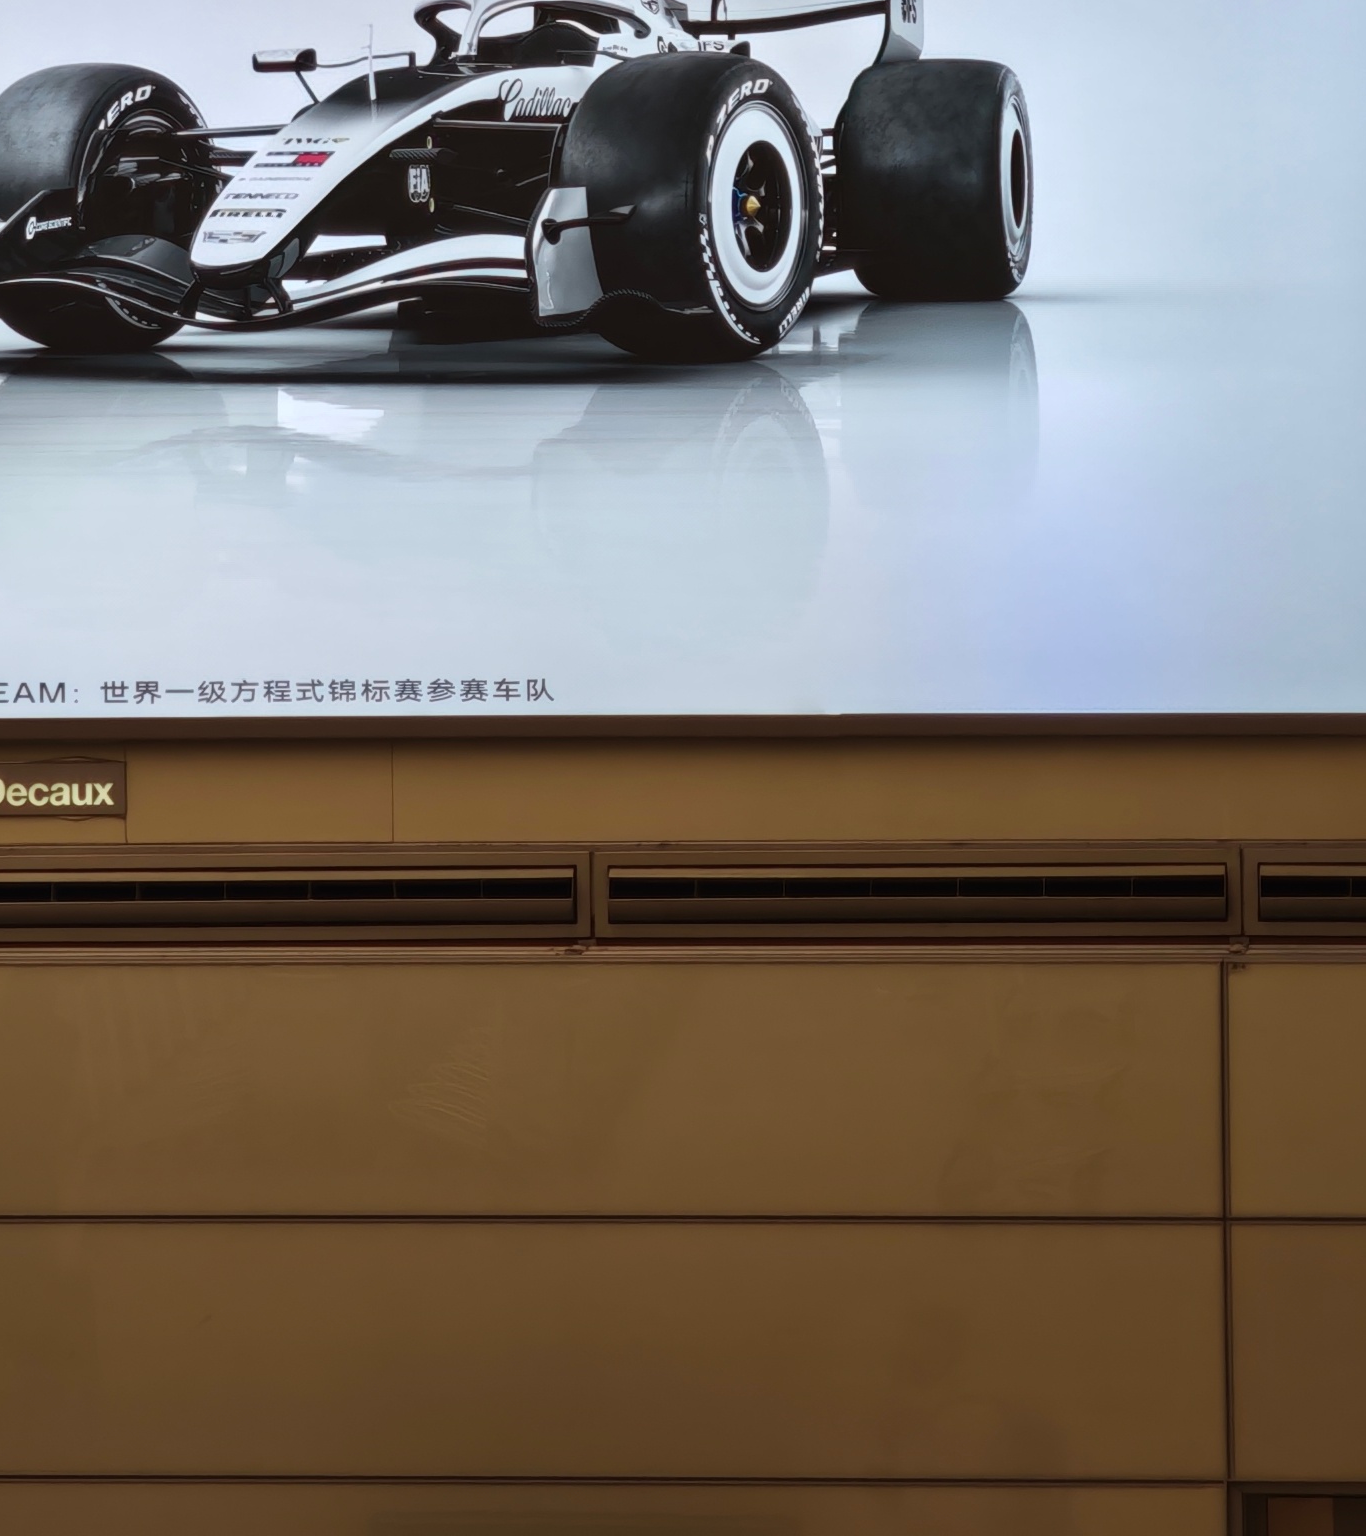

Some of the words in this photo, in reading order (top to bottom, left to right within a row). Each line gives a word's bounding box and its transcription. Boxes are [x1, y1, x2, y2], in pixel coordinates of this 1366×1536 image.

[499, 78, 573, 121] Cadillac
[100, 677, 556, 705] 世界一级方程式锦标赛参赛车队
